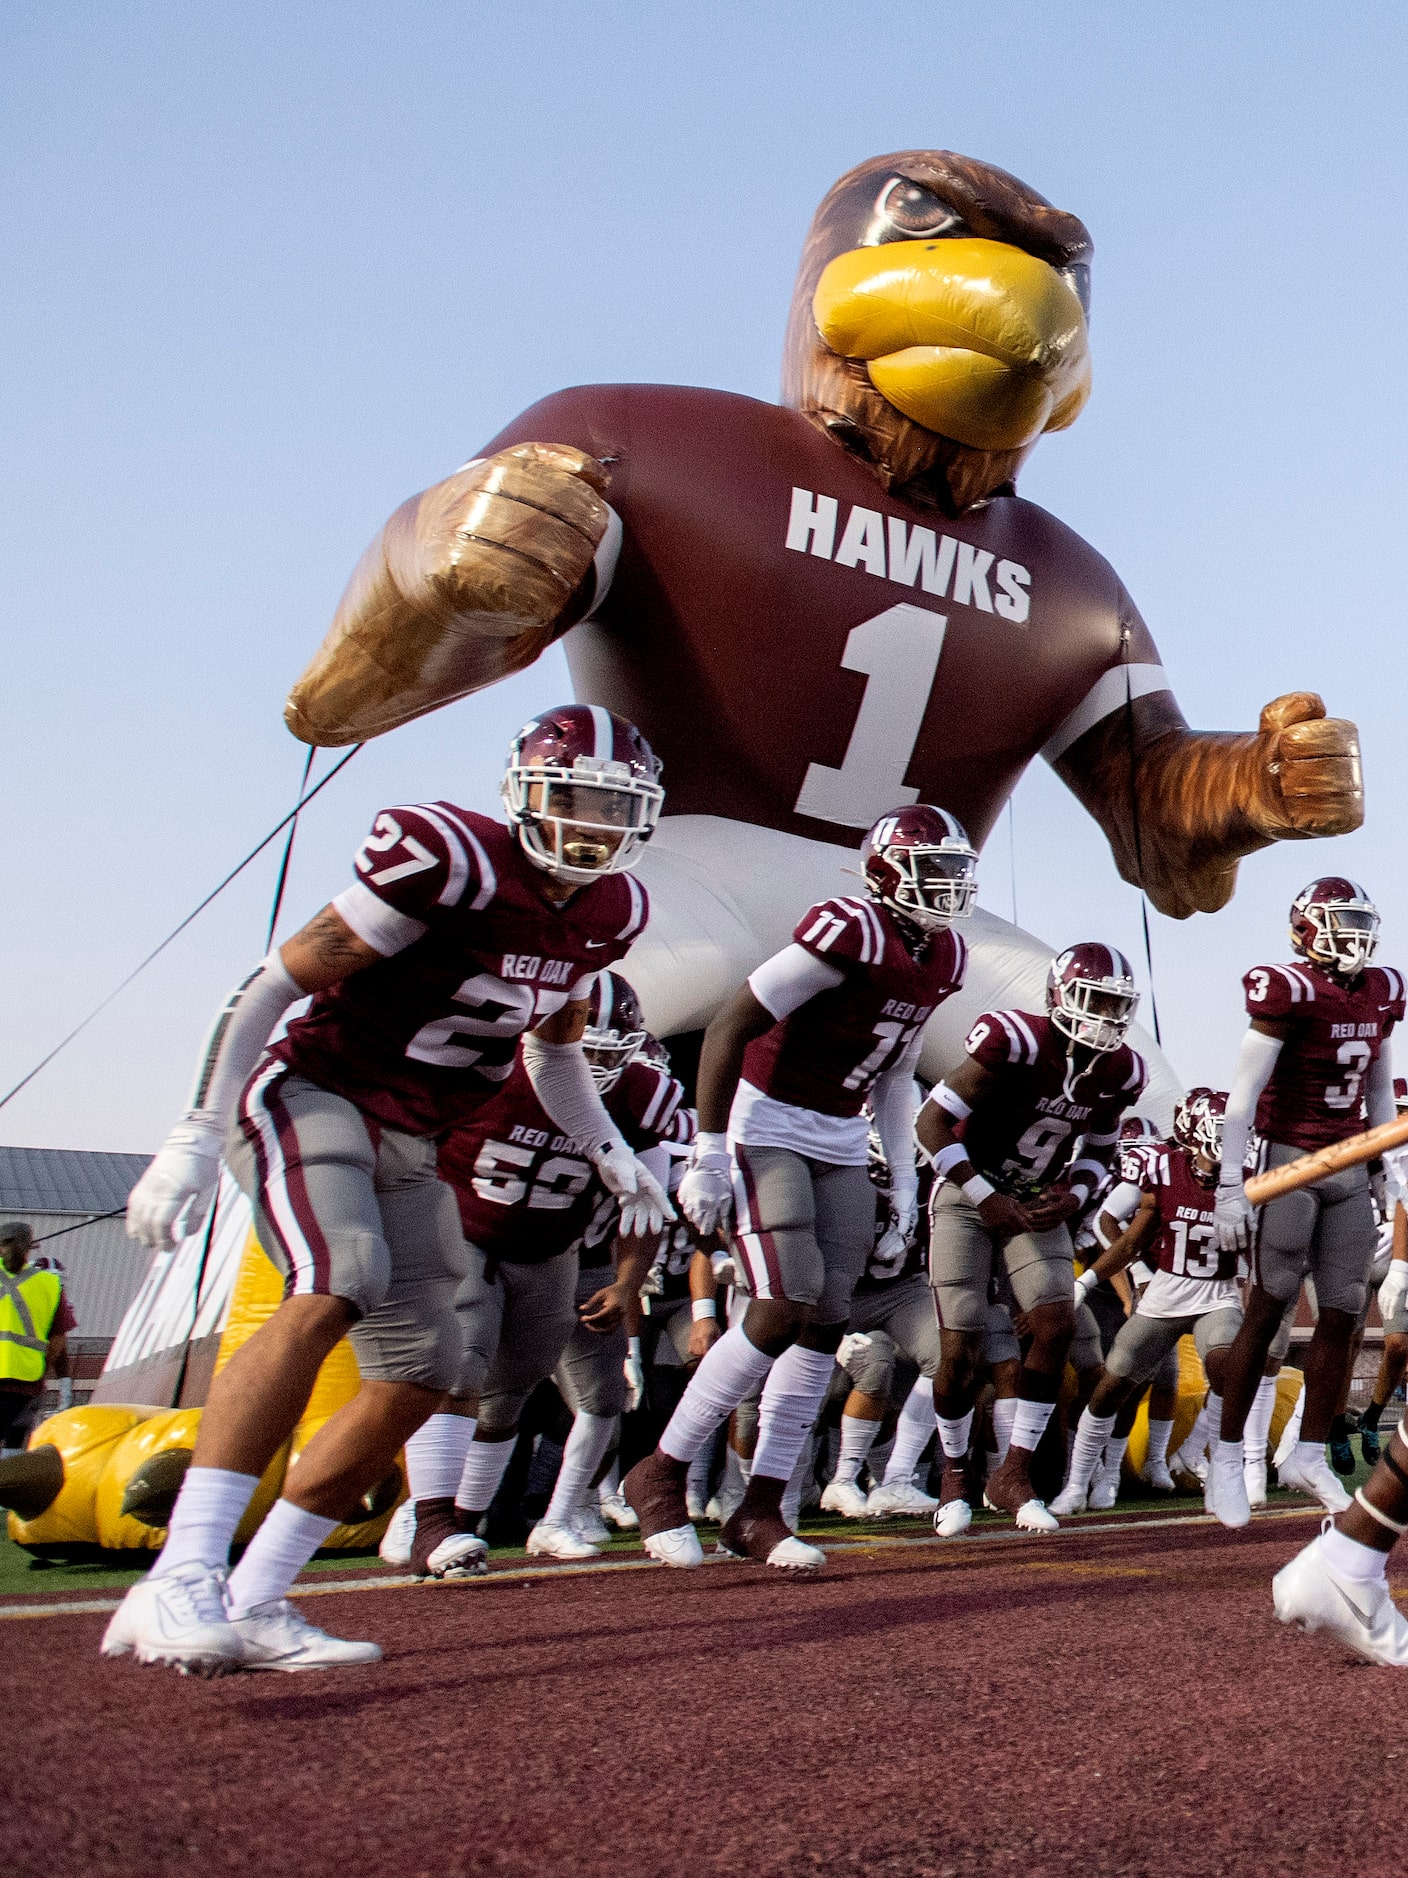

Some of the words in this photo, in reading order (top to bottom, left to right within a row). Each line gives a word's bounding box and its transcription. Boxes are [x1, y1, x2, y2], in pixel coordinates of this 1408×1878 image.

[785, 487, 1031, 623] HAWKS
[793, 602, 947, 830] 1
[871, 817, 899, 845] 11
[354, 813, 440, 886] 27
[802, 911, 847, 952] 11
[502, 953, 539, 980] RED
[539, 959, 574, 985] OAK
[1248, 969, 1270, 1002] 3
[880, 999, 915, 1020] RED
[964, 1022, 991, 1054] 9
[1330, 1022, 1355, 1039] RED
[1357, 1022, 1377, 1038] OAK
[1324, 1041, 1371, 1109] 3
[1035, 1096, 1062, 1116] RED
[1066, 1103, 1093, 1120] OAK
[508, 1124, 550, 1147] RED
[1001, 1116, 1072, 1184] 9
[471, 1139, 592, 1209] 52
[1175, 1205, 1198, 1220] RED
[1200, 1211, 1213, 1222] OA
[1169, 1221, 1219, 1279] 13
